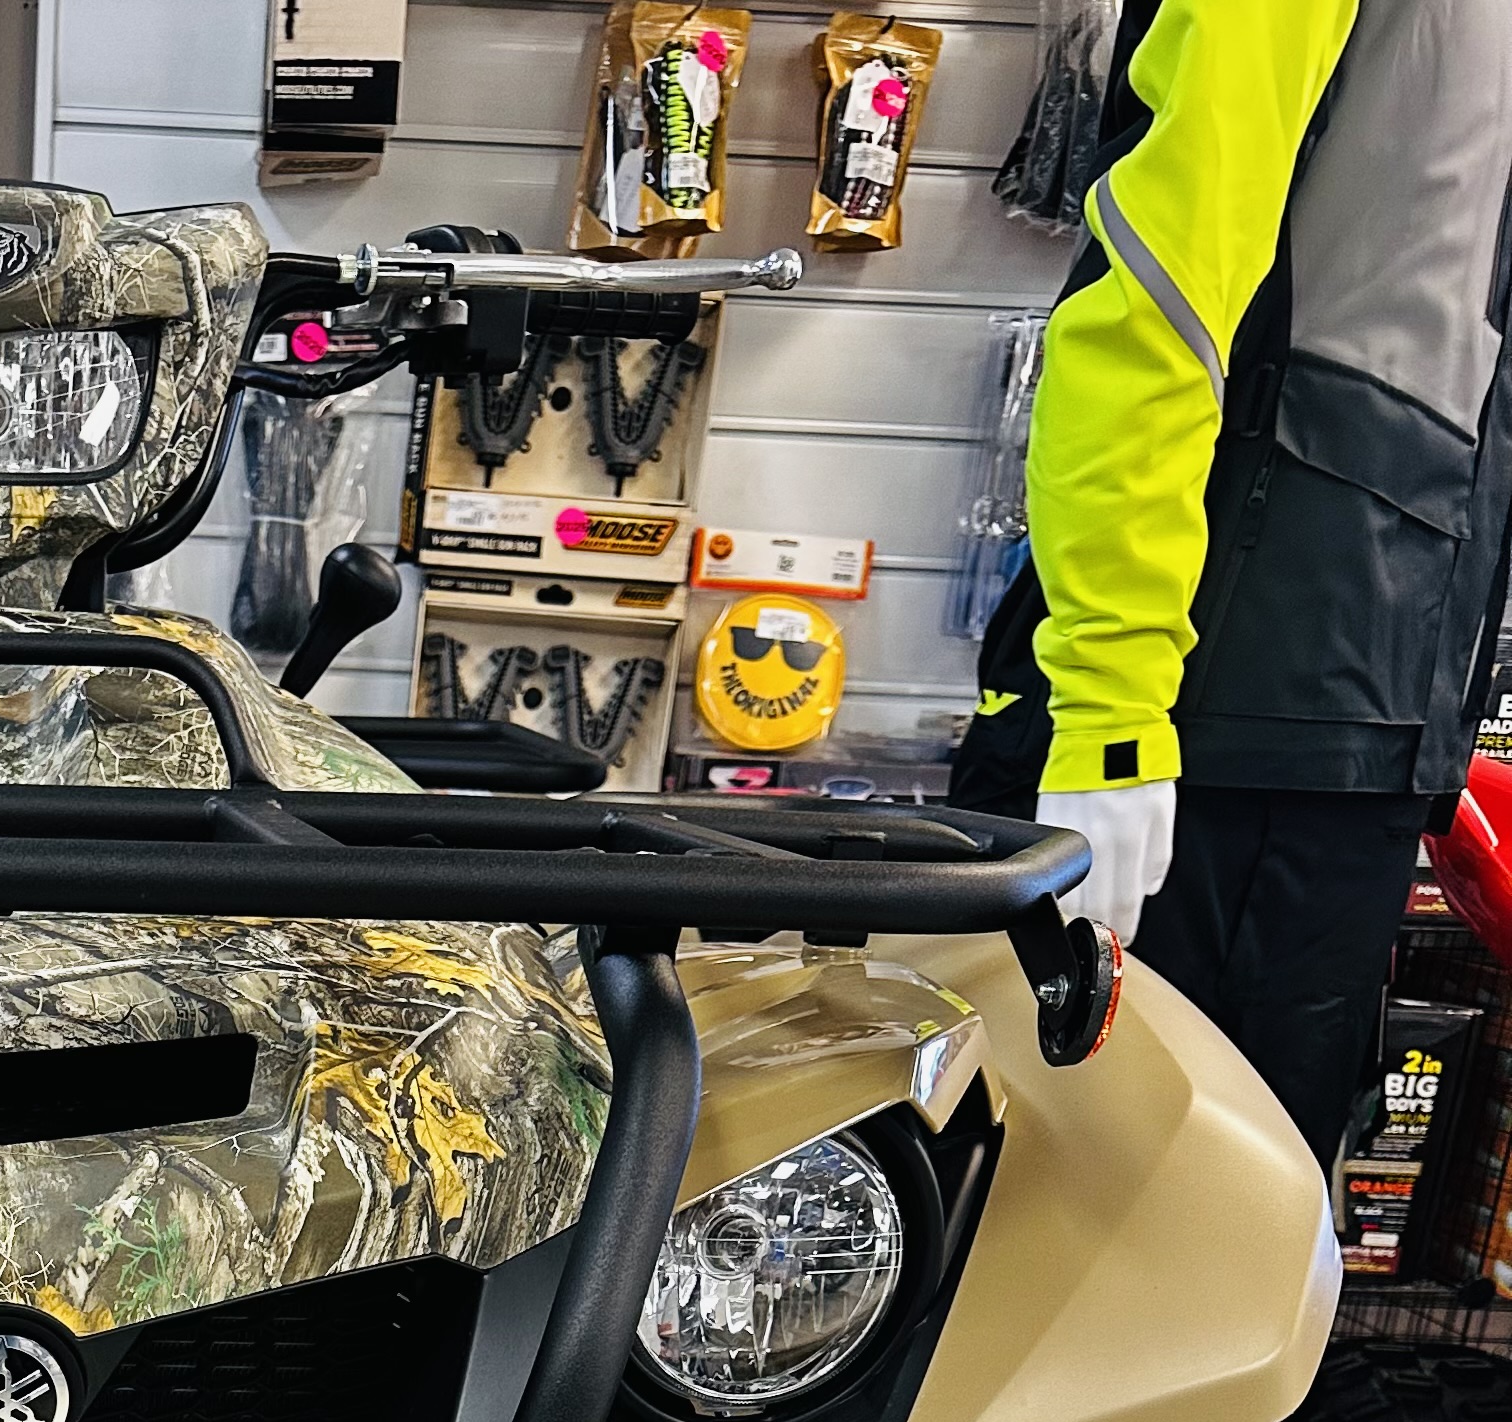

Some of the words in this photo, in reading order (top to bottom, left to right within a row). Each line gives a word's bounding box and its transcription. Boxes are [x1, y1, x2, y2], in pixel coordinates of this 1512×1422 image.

[585, 519, 669, 543] MOOSE
[720, 661, 746, 696] THE
[733, 675, 820, 719] ORIGINAL
[1384, 1073, 1439, 1098] BIG
[1386, 1098, 1434, 1113] DDY'S
